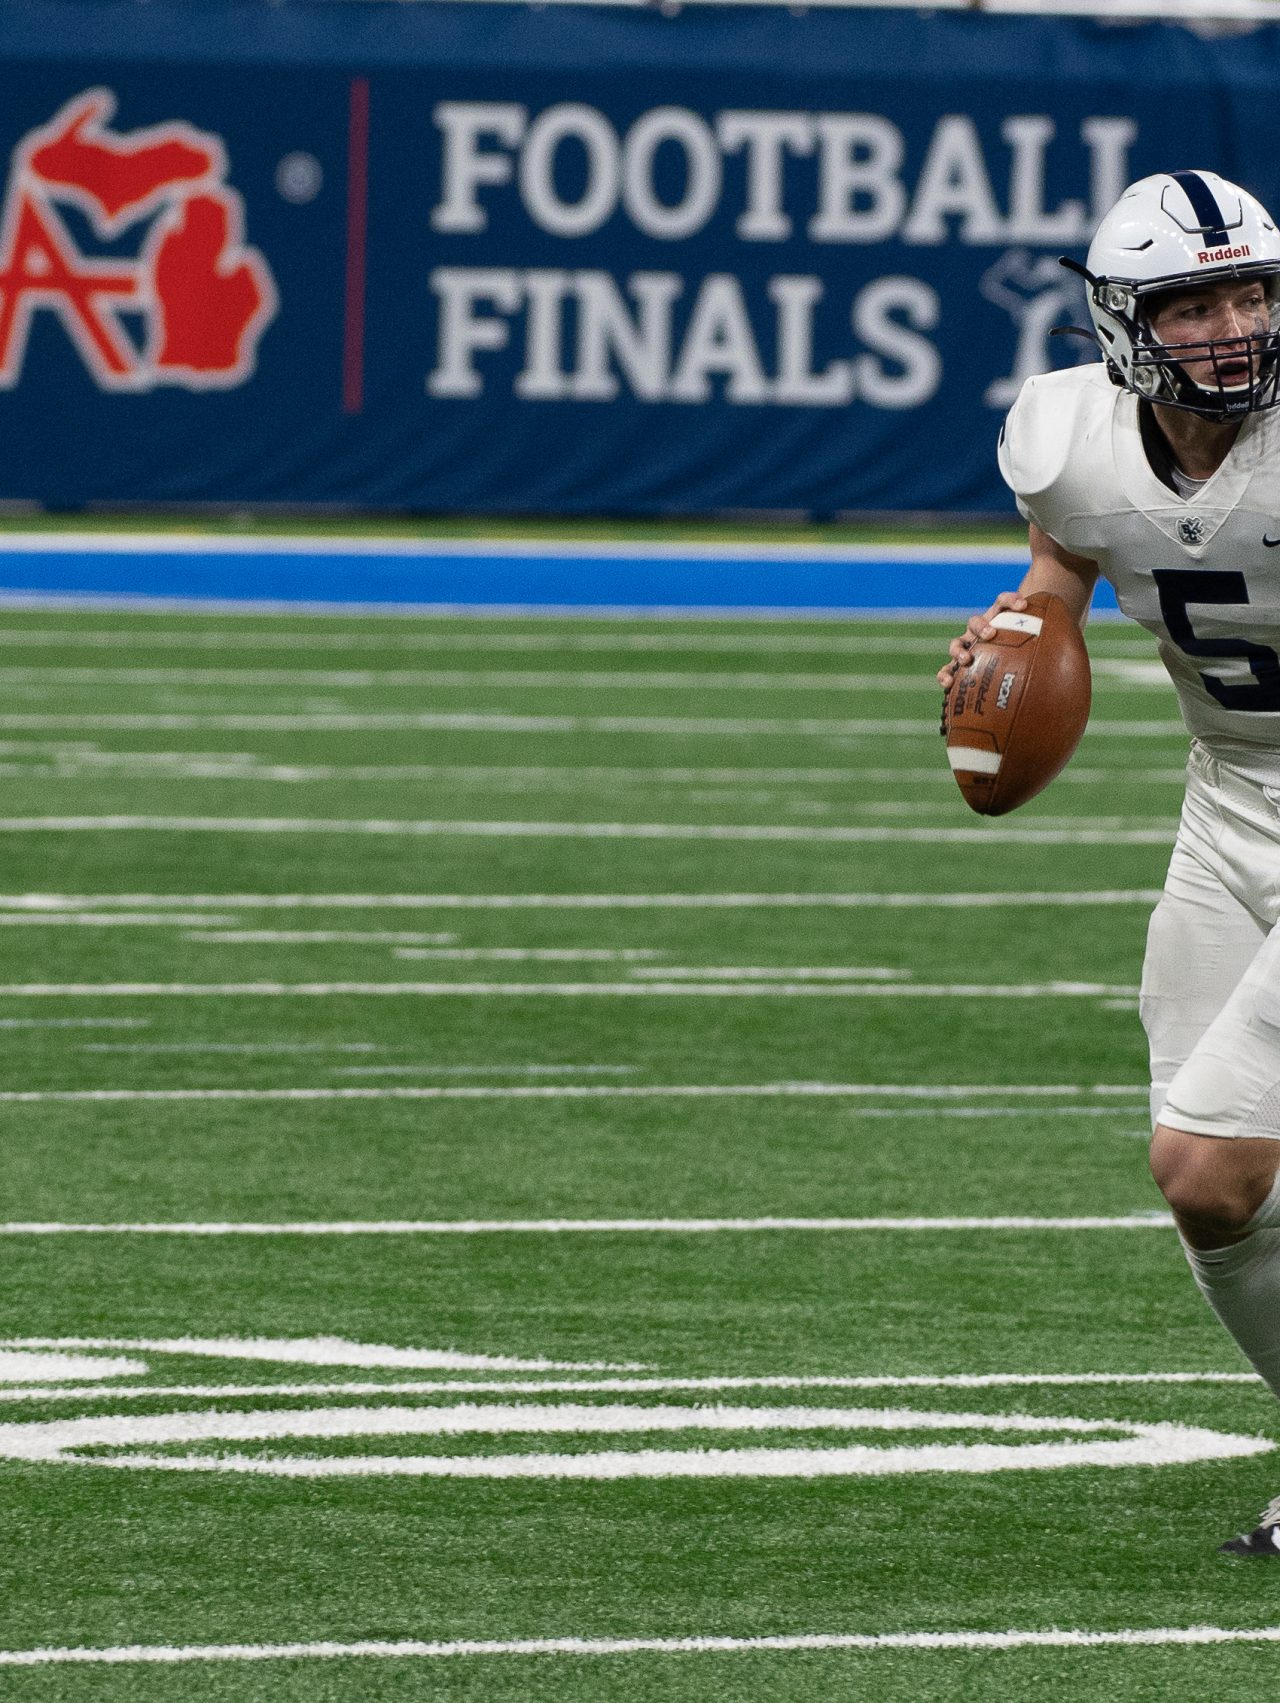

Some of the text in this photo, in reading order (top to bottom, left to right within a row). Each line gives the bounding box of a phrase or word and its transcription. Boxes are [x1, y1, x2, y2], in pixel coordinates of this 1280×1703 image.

[1198, 245, 1250, 263] Riddell
[426, 267, 942, 407] FINALS
[996, 672, 1016, 709] NCAA
